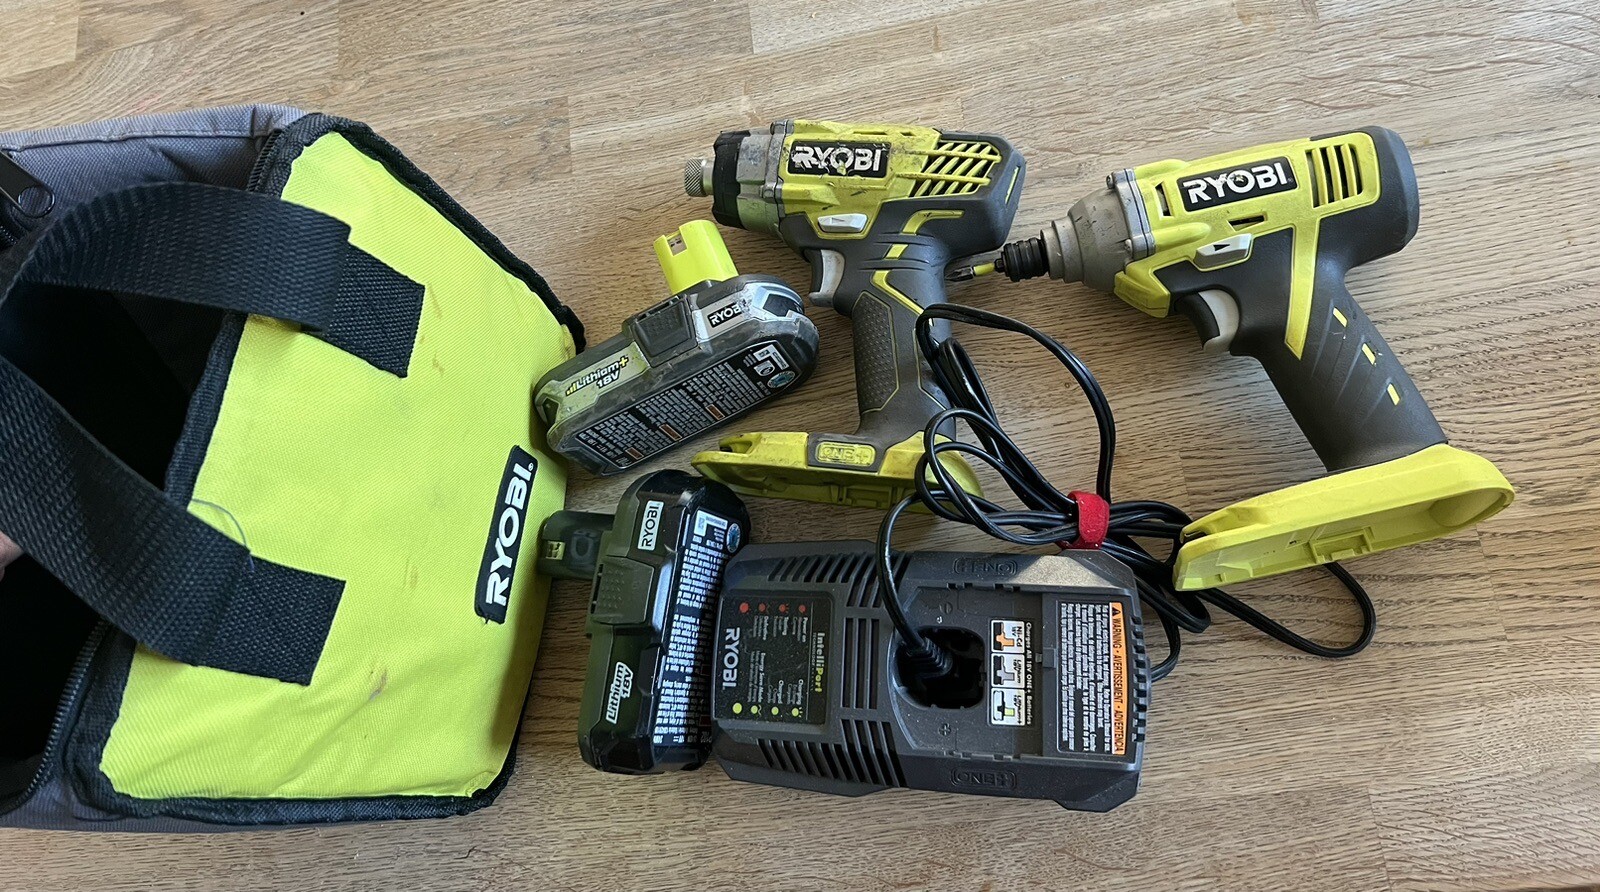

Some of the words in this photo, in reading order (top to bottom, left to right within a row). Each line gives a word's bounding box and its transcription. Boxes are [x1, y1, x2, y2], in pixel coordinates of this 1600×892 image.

[791, 145, 881, 172] RYOBI
[1182, 162, 1288, 204] RYOBI
[709, 303, 746, 325] RYOB
[597, 370, 619, 386] 18V
[486, 462, 532, 607] RYOBI
[641, 506, 659, 547] RYOBI
[1112, 618, 1122, 648] WARNING
[722, 627, 740, 687] RYOBI
[815, 632, 825, 692] IntelliPort
[608, 664, 624, 721] Lithium
[622, 668, 631, 695] 18V
[1113, 655, 1123, 703] AVERTISSEMENT
[1114, 710, 1124, 751] ADVERTENCIA
